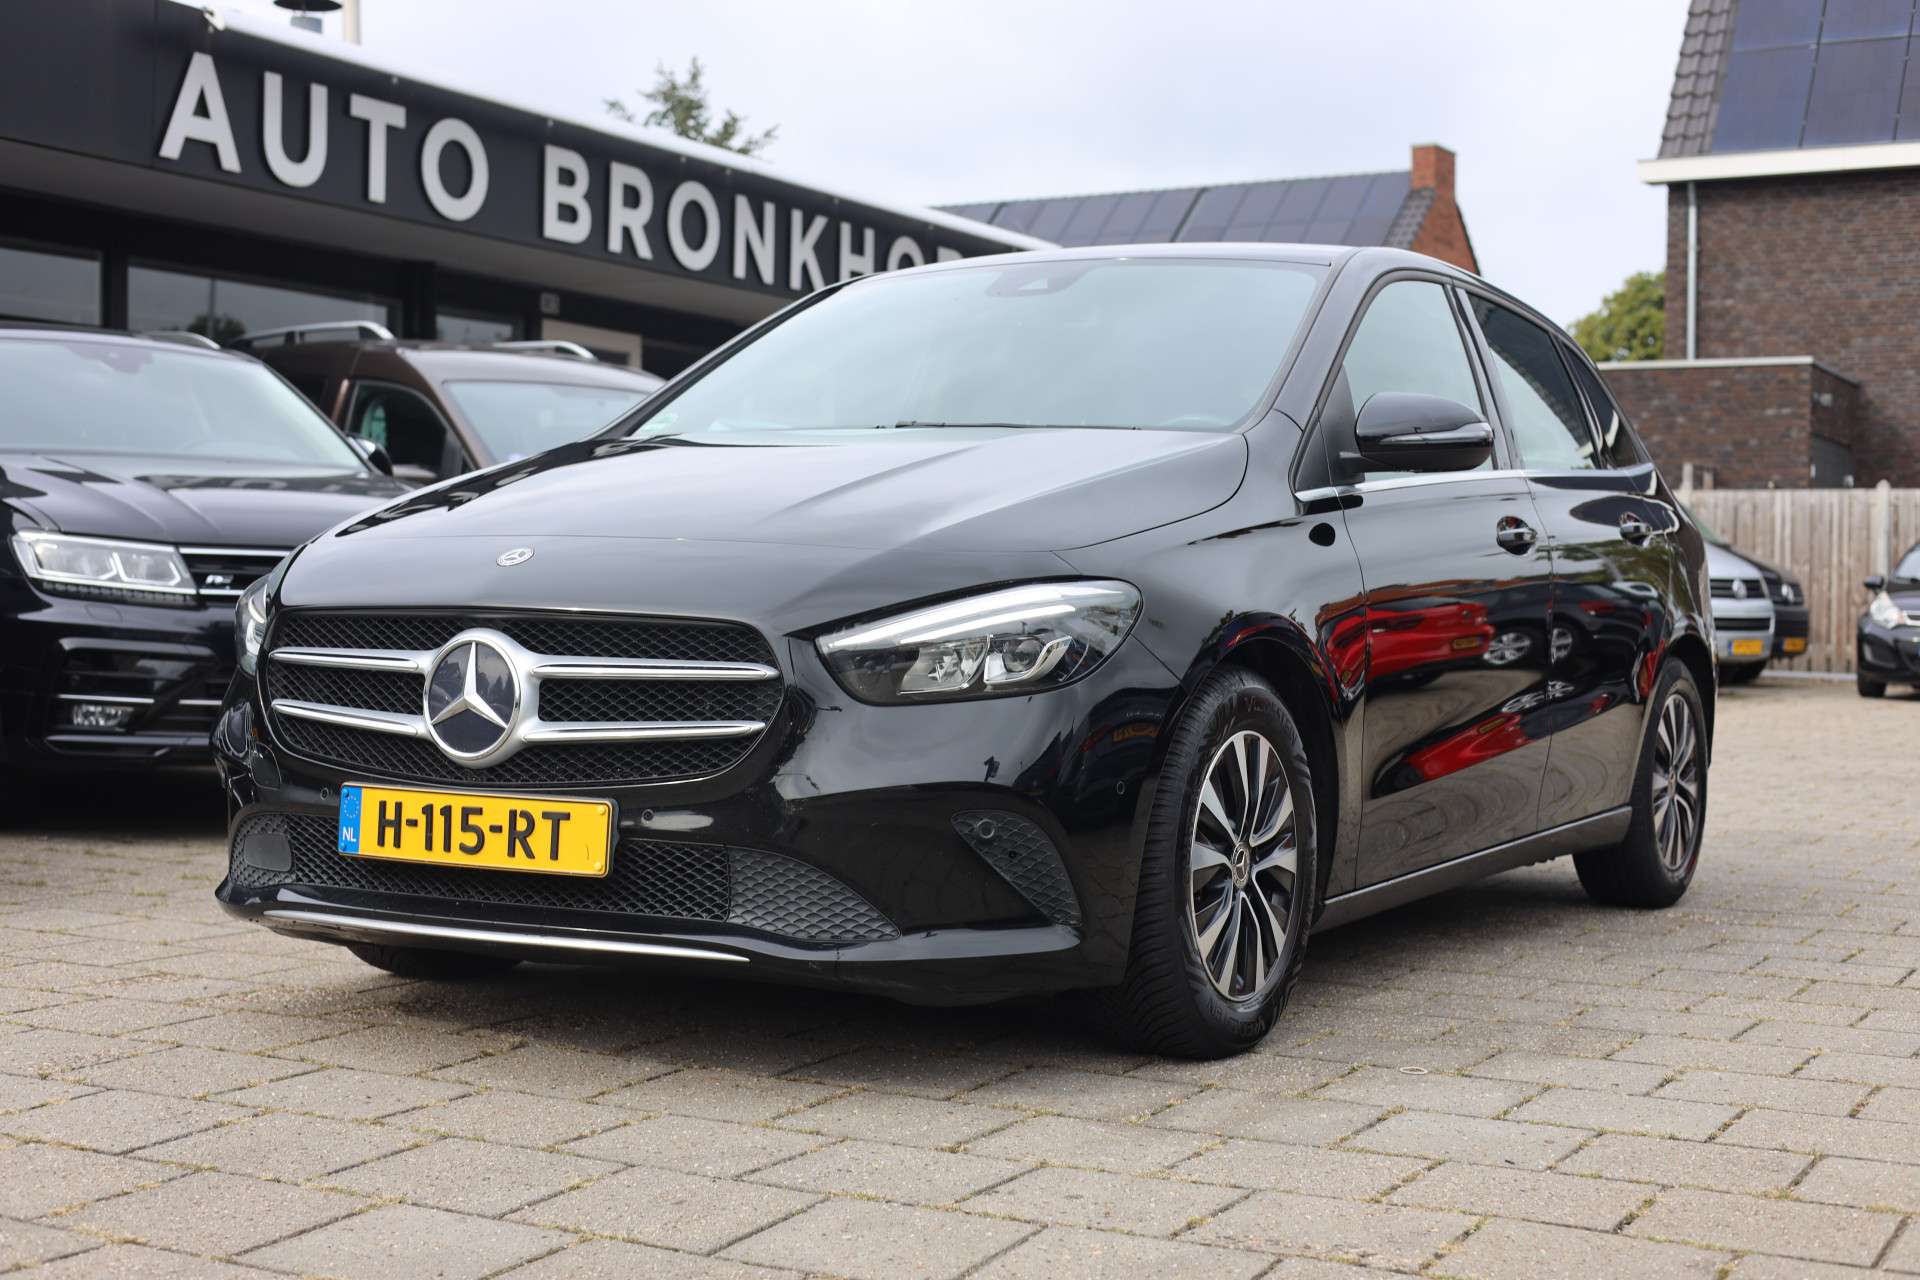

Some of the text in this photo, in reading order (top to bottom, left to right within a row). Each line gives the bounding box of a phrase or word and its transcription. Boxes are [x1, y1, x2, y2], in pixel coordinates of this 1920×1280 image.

[158, 51, 964, 291] AUTO BRONKHO
[342, 826, 357, 842] NL
[376, 800, 571, 861] H-115-RT
